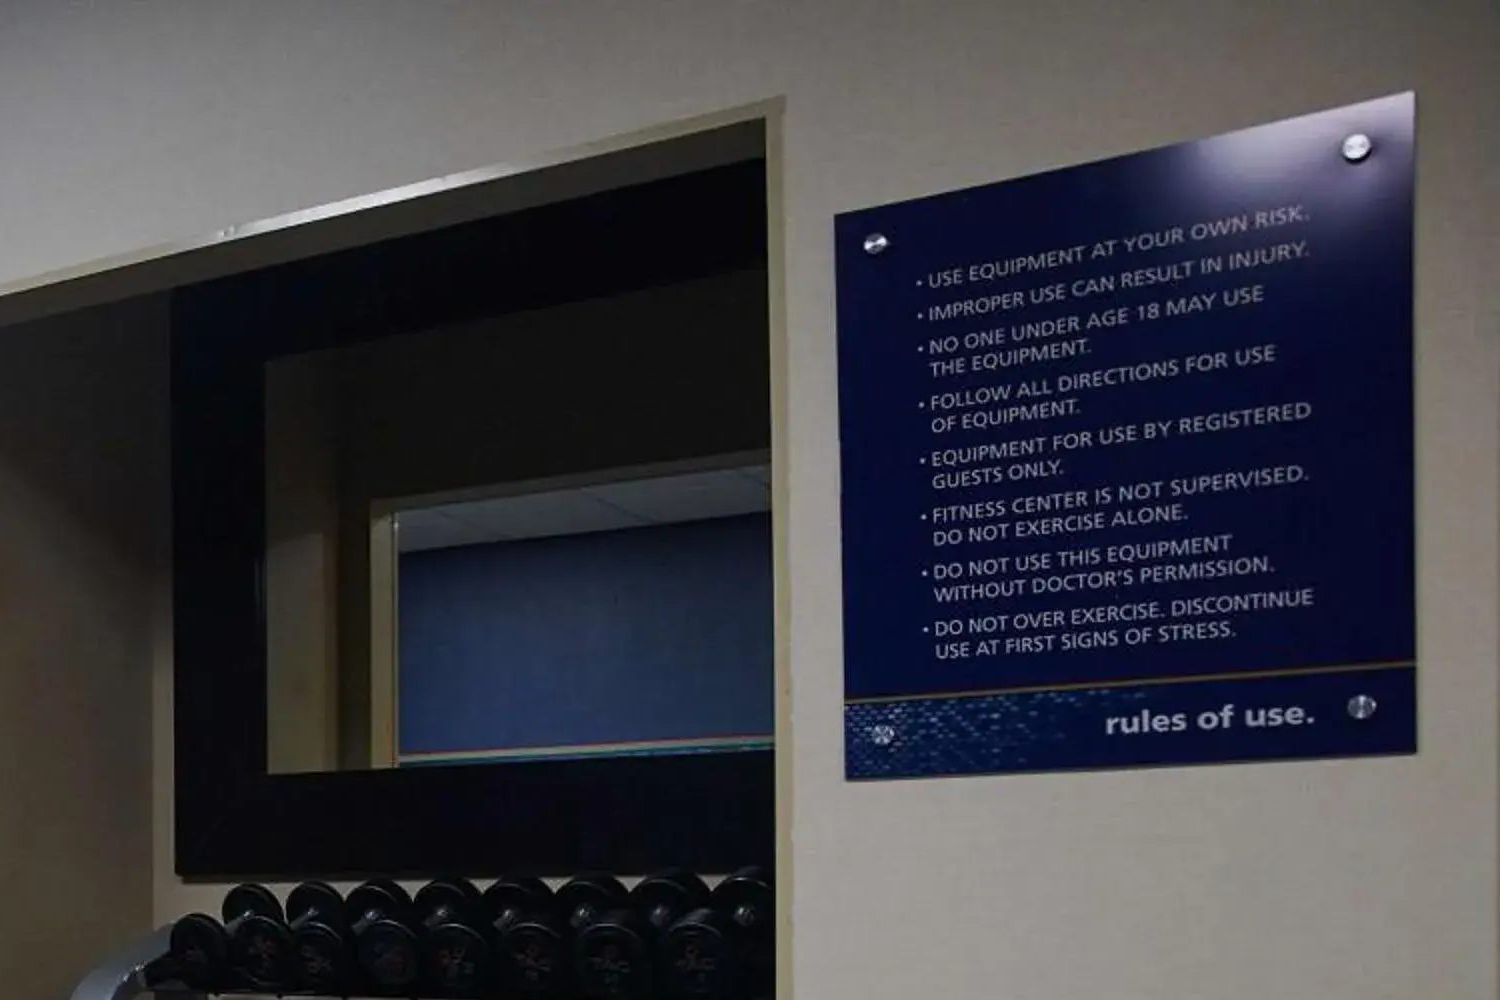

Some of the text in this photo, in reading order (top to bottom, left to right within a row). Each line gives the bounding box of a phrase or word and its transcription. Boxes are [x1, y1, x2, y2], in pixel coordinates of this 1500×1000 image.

[927, 206, 1312, 288] USE EQUIPMENT AT YOUR OWN RISK.
[927, 241, 1310, 321] IMPROPER USE CAN RESULT IN INJURY.
[928, 284, 1265, 354] NO ONE UNDER AGE 18 MAY USE
[928, 337, 1092, 377] THE EQUIPMENT.
[929, 344, 1275, 411] FOLLOW ALL DIRECTIONS FOR USE
[930, 398, 1080, 433] OF EQUIPMENT.
[930, 402, 1312, 467] EQUIPMENT FOR USE BY REGISTERED
[931, 458, 1064, 489] GUESTS ONLY.
[931, 465, 1310, 524] FITNESS CENTER IS NOT SUPERVISED.
[932, 503, 1189, 546] DO NOT EXERCISE ALONE.
[932, 534, 1233, 580] DO NOT USE THIS EQUIPMENT
[932, 579, 1028, 602] WITHOUT
[1139, 556, 1274, 583] PERMISSION.
[933, 588, 1314, 637] DO NOT OVER EXERCISE. DISCONTINUE
[934, 620, 1236, 659] USE AT FIRST SIGNS OF STRESS.
[1106, 703, 1314, 735] rules of use.
